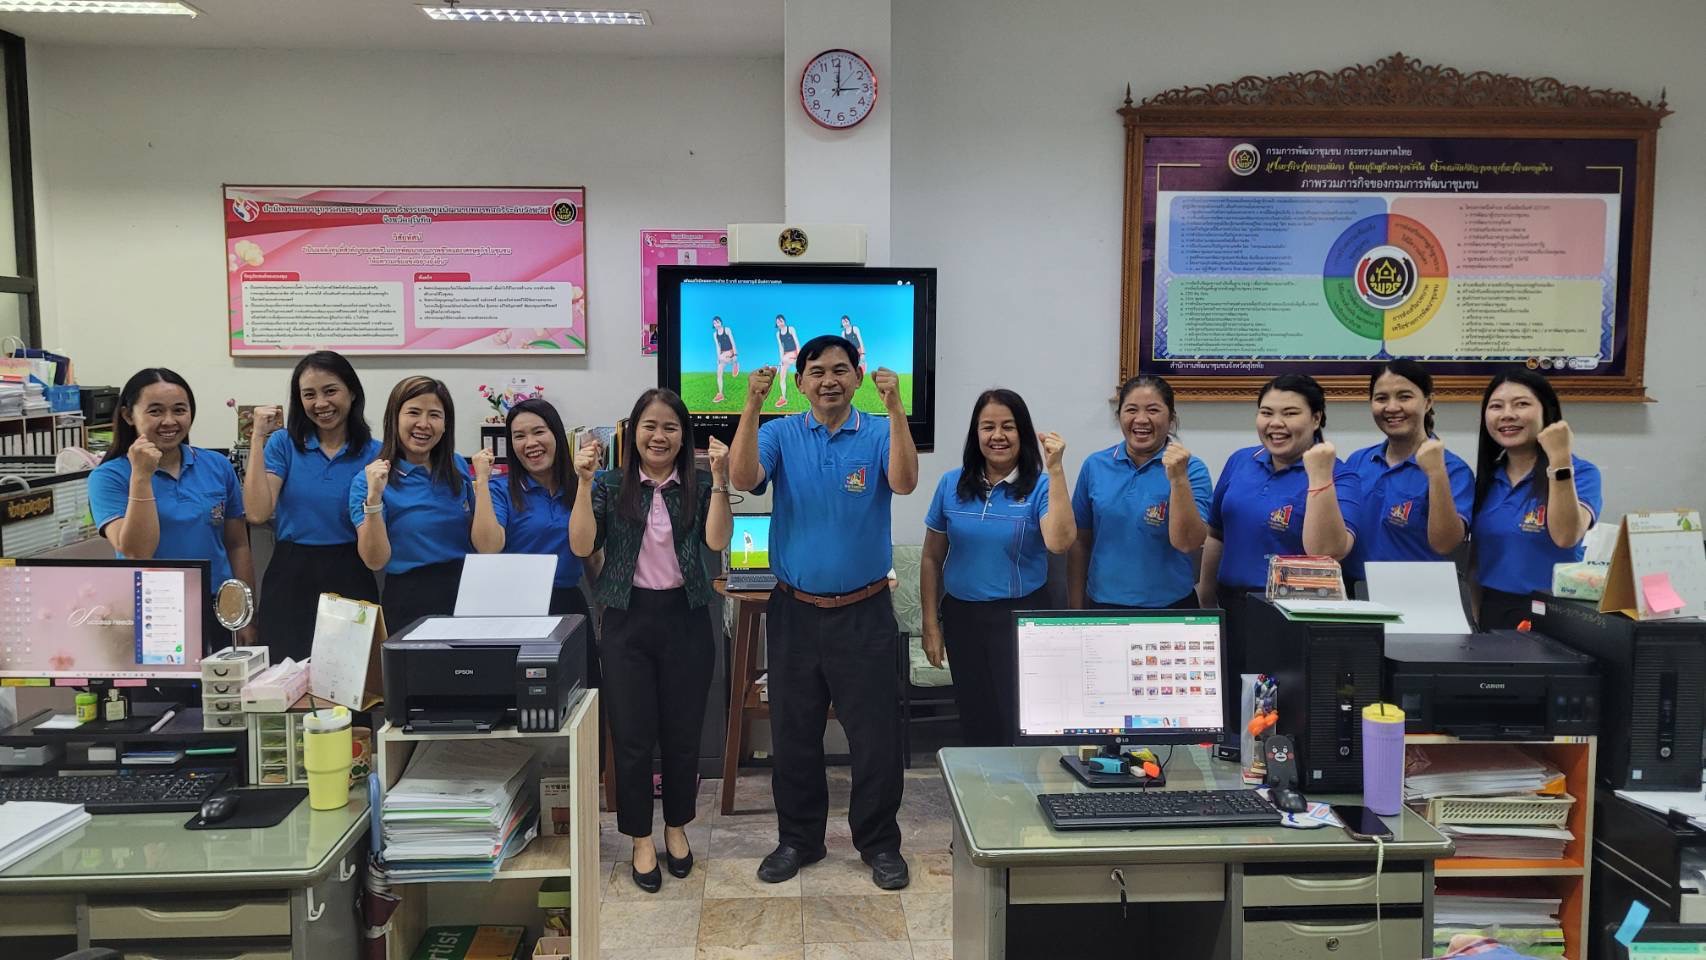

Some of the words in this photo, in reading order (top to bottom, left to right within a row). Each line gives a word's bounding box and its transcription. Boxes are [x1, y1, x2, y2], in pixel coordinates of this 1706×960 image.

[820, 62, 828, 72] 11
[832, 58, 841, 68] 12
[848, 61, 853, 70] 1
[811, 73, 821, 84] 10
[856, 71, 864, 81] 2
[807, 87, 816, 97] 9
[862, 83, 869, 93] 3
[813, 99, 820, 110] 8
[857, 96, 865, 106] 4
[824, 109, 831, 119] 7
[849, 106, 858, 117] 5
[837, 112, 845, 122] 6
[1266, 145, 1341, 158] กรมการพัฒนาชุมชน
[1343, 145, 1413, 157] กระทรวงมหาดไทย
[1301, 176, 1479, 193] ภาพรวมภารกิจของกรมการพัฒนาชุมชน
[428, 931, 466, 960] rtist
